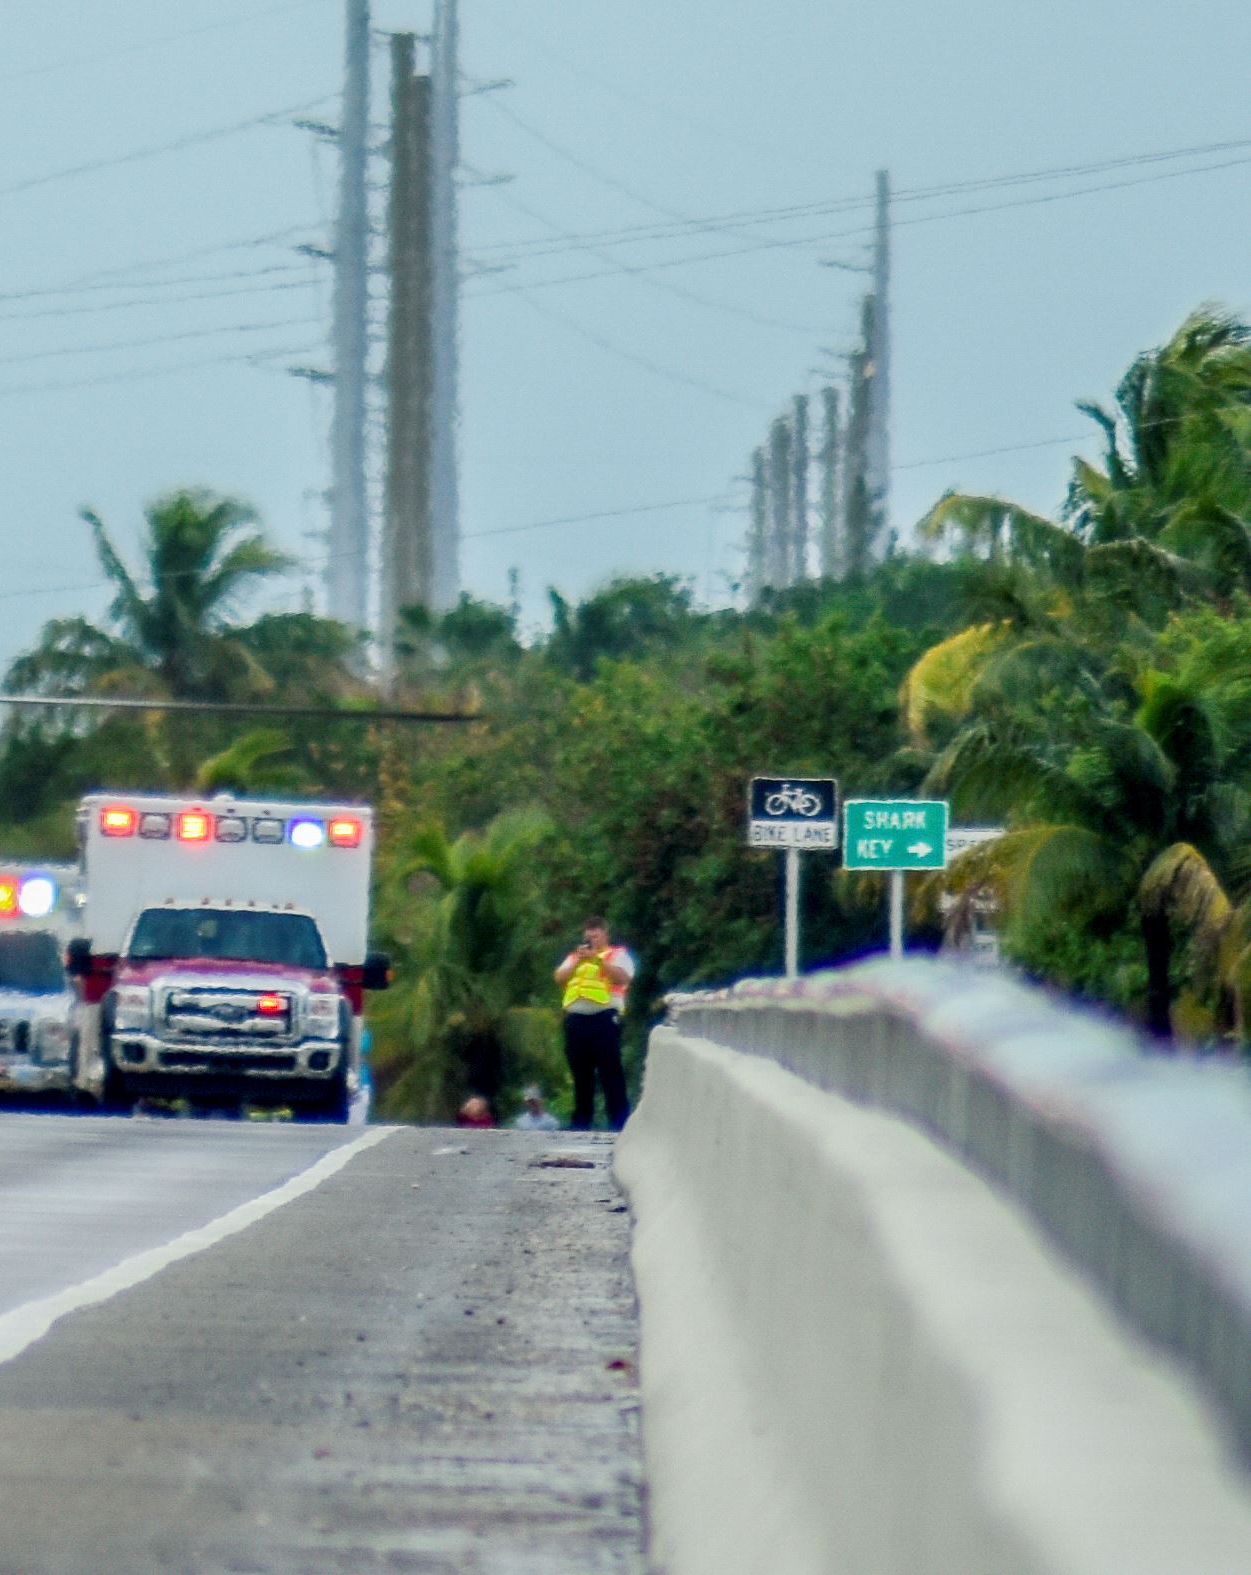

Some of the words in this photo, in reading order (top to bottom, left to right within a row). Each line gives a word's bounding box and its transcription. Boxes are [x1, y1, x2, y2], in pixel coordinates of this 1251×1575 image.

[864, 811, 926, 830] SHARK
[753, 825, 786, 842] BIKE
[794, 826, 831, 843] LANE
[857, 839, 894, 859] KEY
